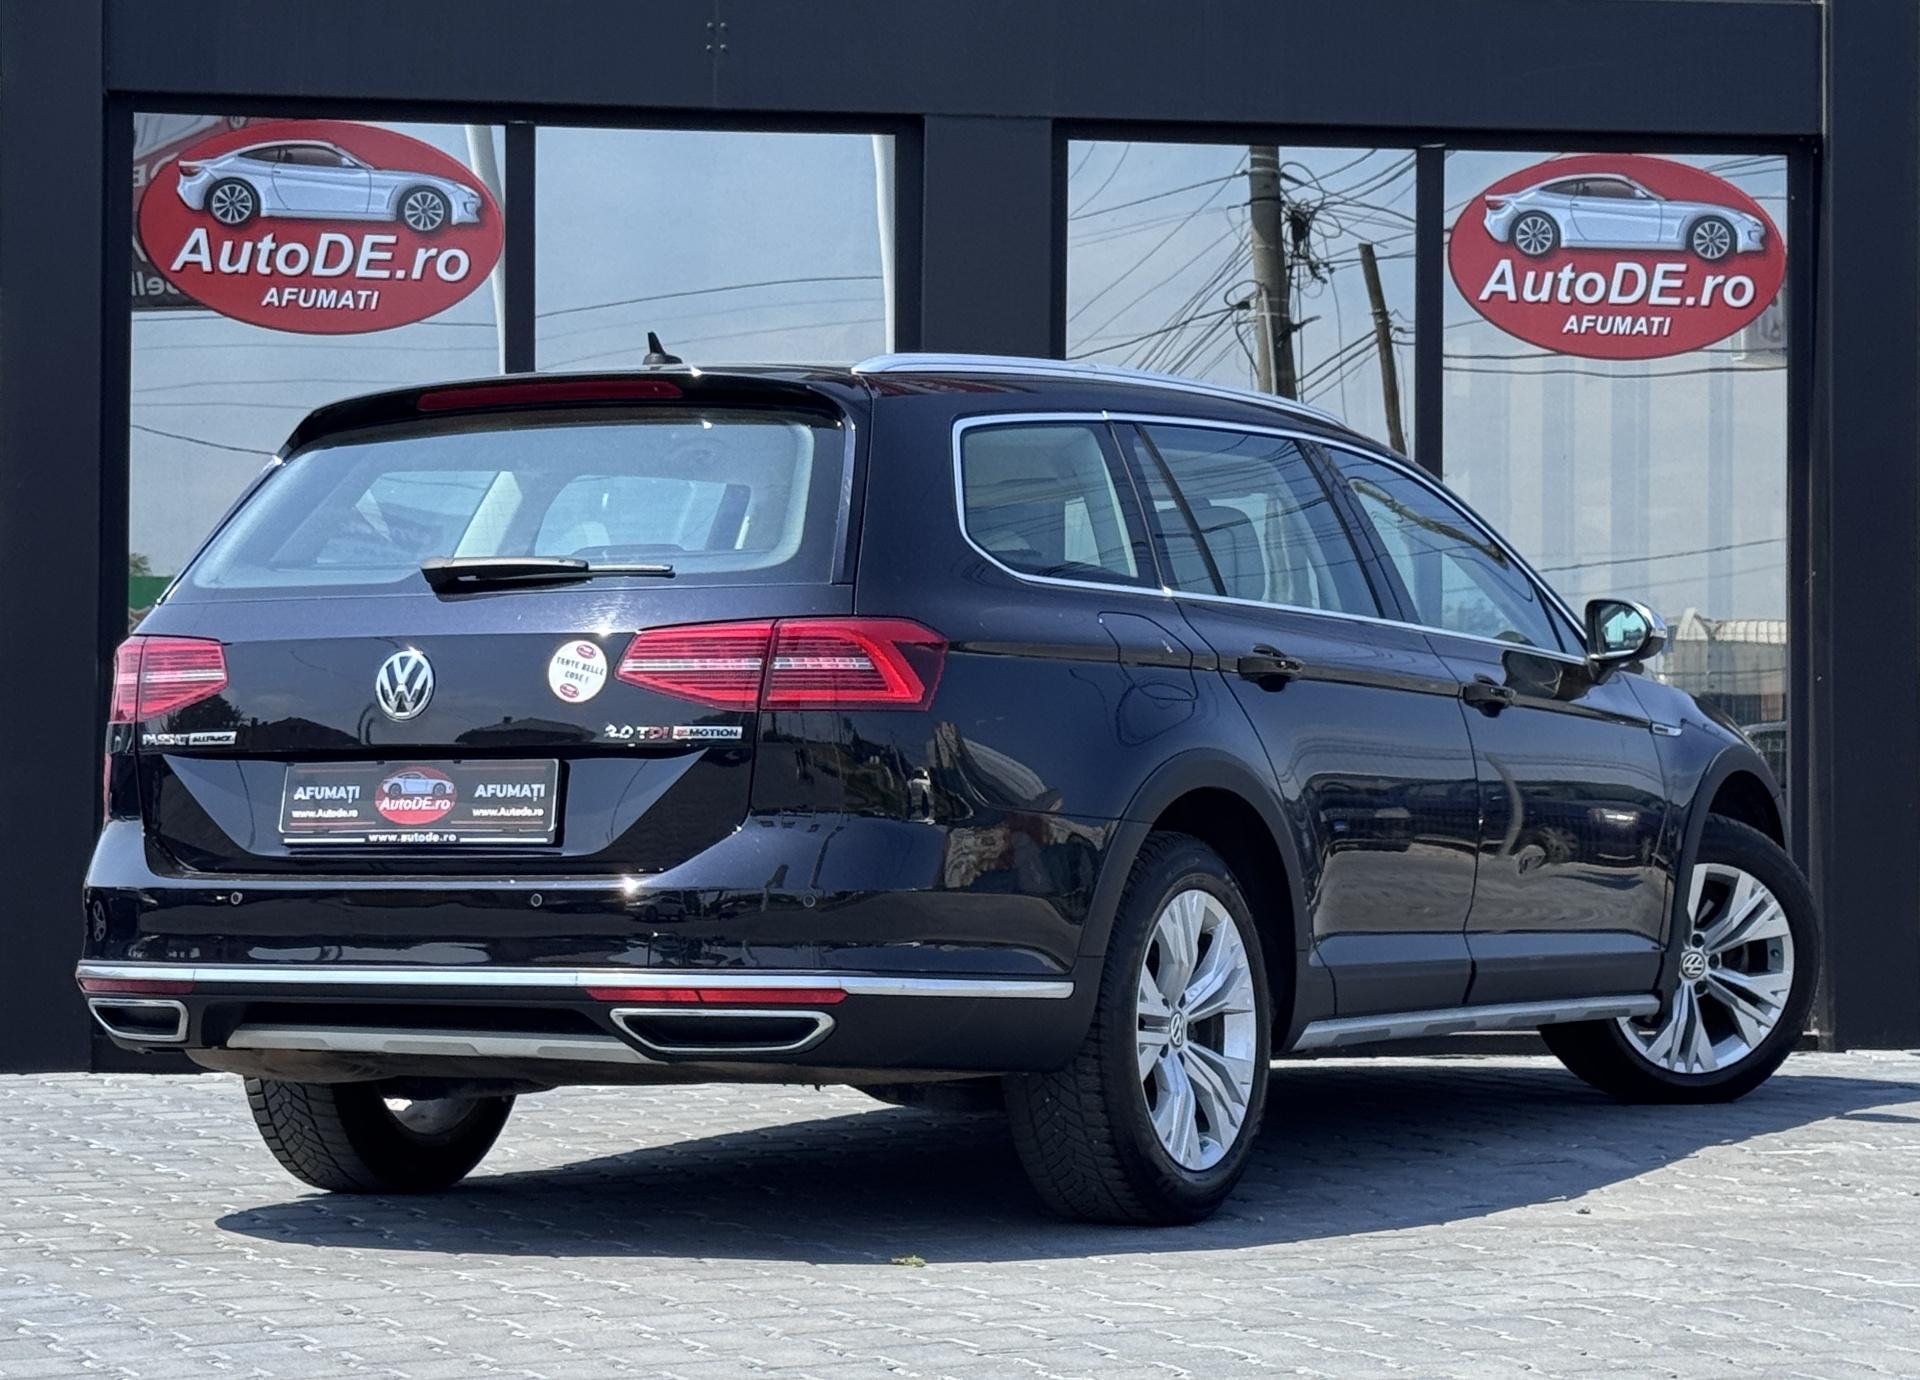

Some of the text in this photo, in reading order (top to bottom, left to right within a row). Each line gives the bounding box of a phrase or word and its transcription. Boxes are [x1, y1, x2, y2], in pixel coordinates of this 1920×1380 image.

[170, 227, 471, 282] AutoDE.ro
[1478, 259, 1755, 308] AutoDE.ro
[262, 287, 379, 311] AFUMATI
[1562, 316, 1671, 337] AFUMATI
[380, 796, 450, 811] AutoDE.ro
[368, 832, 457, 843] www.autode.ro
